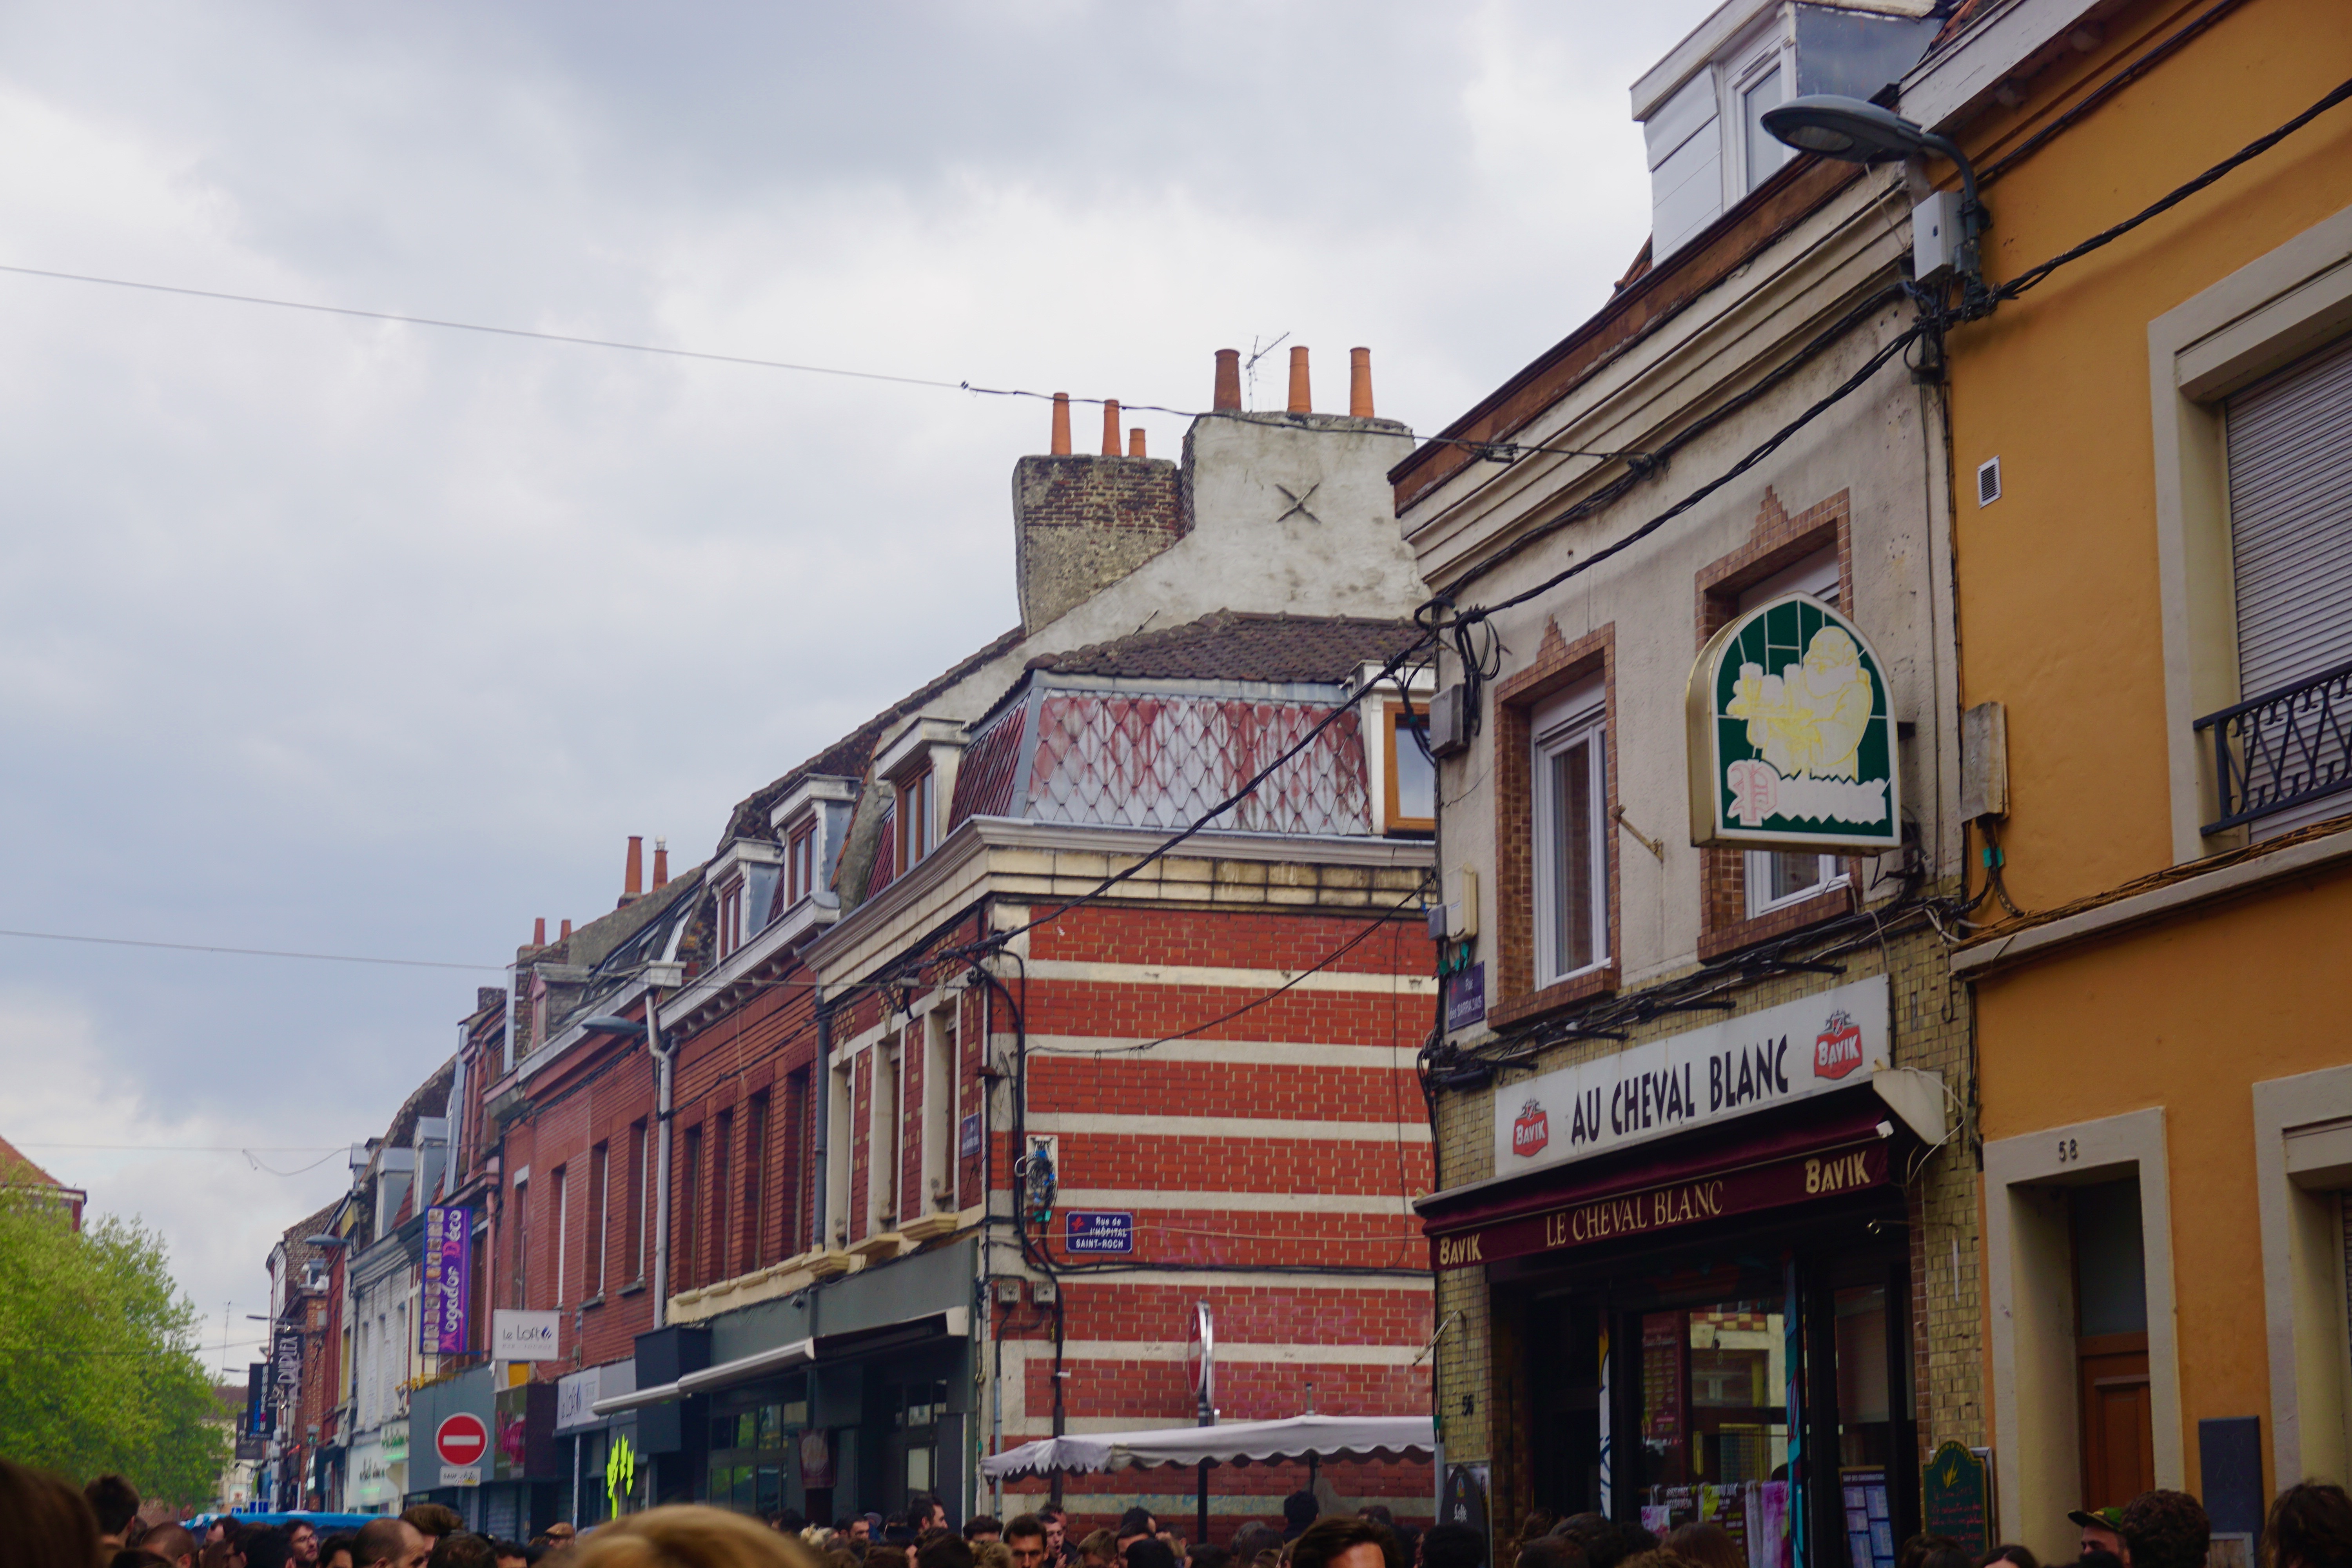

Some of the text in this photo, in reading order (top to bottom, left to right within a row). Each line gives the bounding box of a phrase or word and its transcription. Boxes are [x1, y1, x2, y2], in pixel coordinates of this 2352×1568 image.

[1818, 1034, 1860, 1067] BAVIK
[1571, 1033, 1788, 1147] AU CHEVAL BLANC
[1515, 1120, 1546, 1146] BAVIK
[2059, 1138, 2078, 1162] 58
[1805, 1150, 1871, 1194] BAVIK
[1096, 1216, 1122, 1226] Rue de
[1546, 1180, 1723, 1247] LE CHEVAL BLANC
[1076, 1238, 1123, 1249] SAINT-ROCH
[1439, 1232, 1483, 1265] BAVIK
[439, 1265, 464, 1351] Mogador
[277, 1336, 298, 1384] DUPLEX
